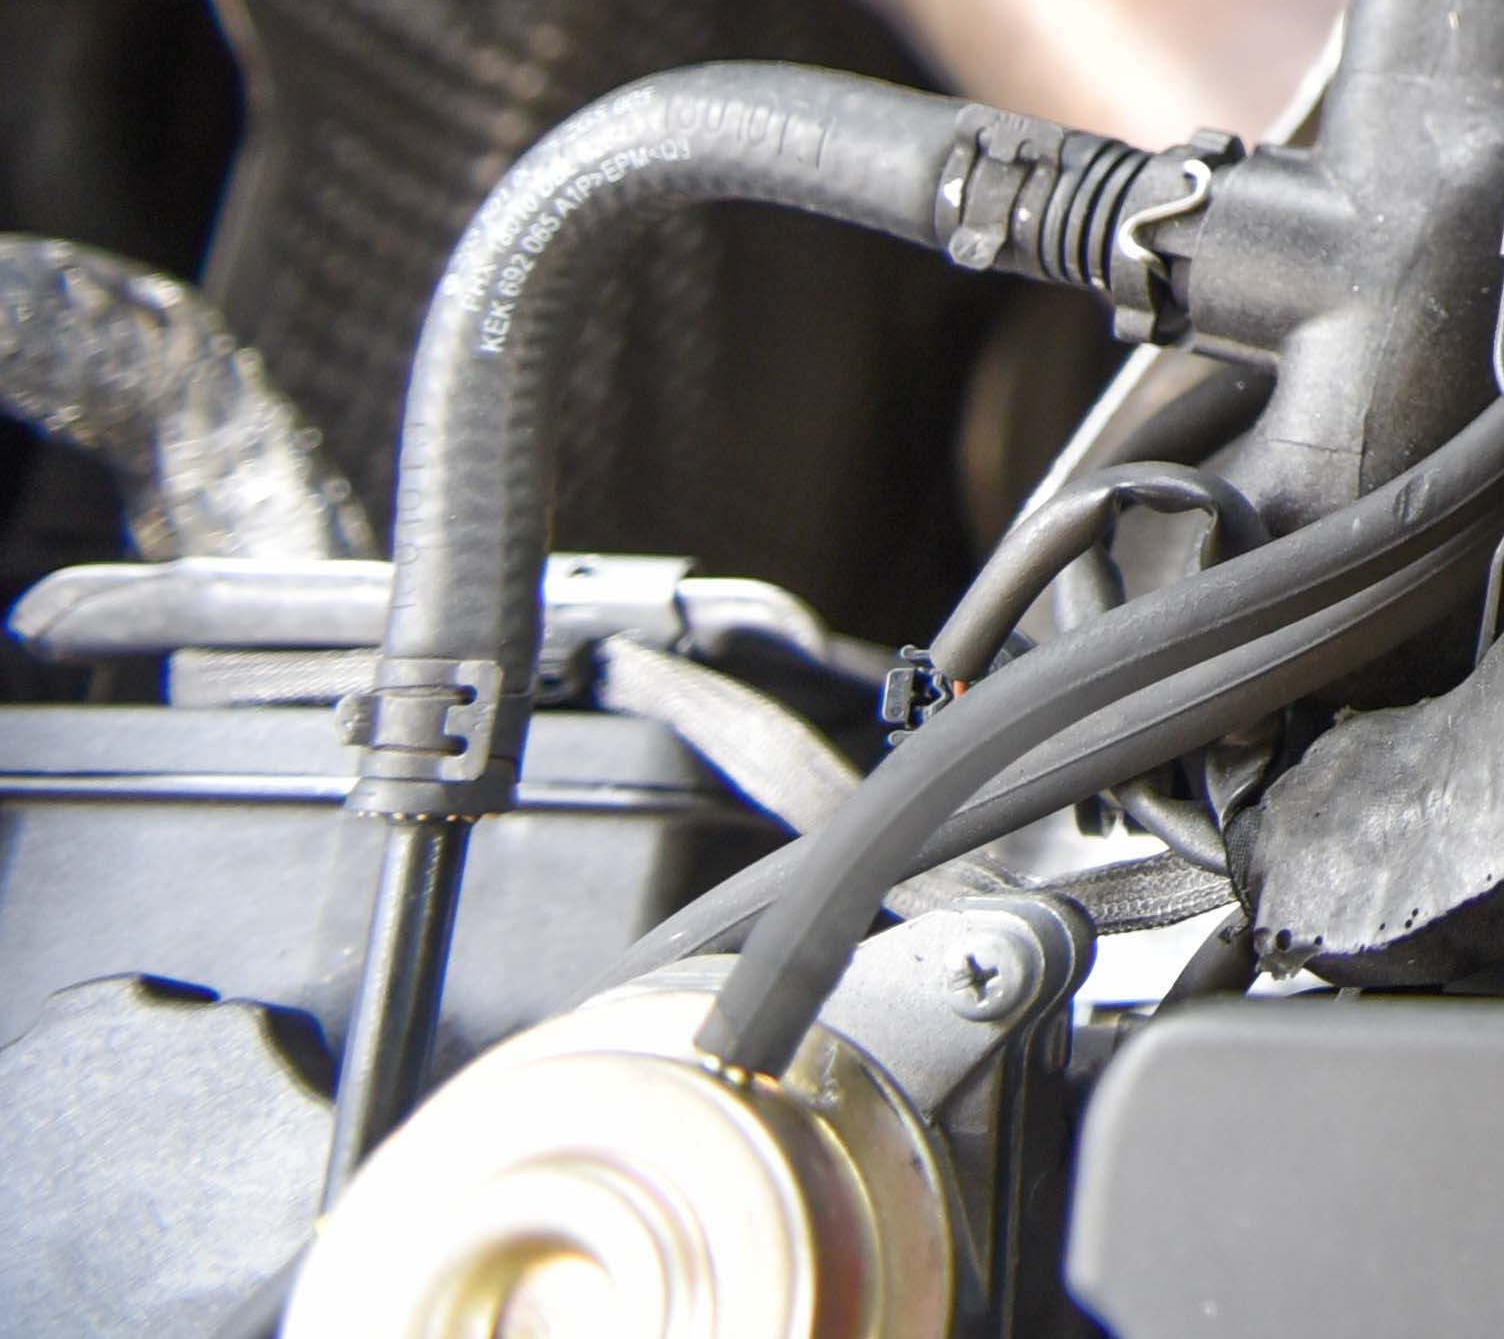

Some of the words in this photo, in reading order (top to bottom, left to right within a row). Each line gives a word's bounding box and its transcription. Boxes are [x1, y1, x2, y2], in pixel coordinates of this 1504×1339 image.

[480, 299, 515, 353] KEK
[499, 254, 536, 297] 692
[522, 213, 560, 254] 065
